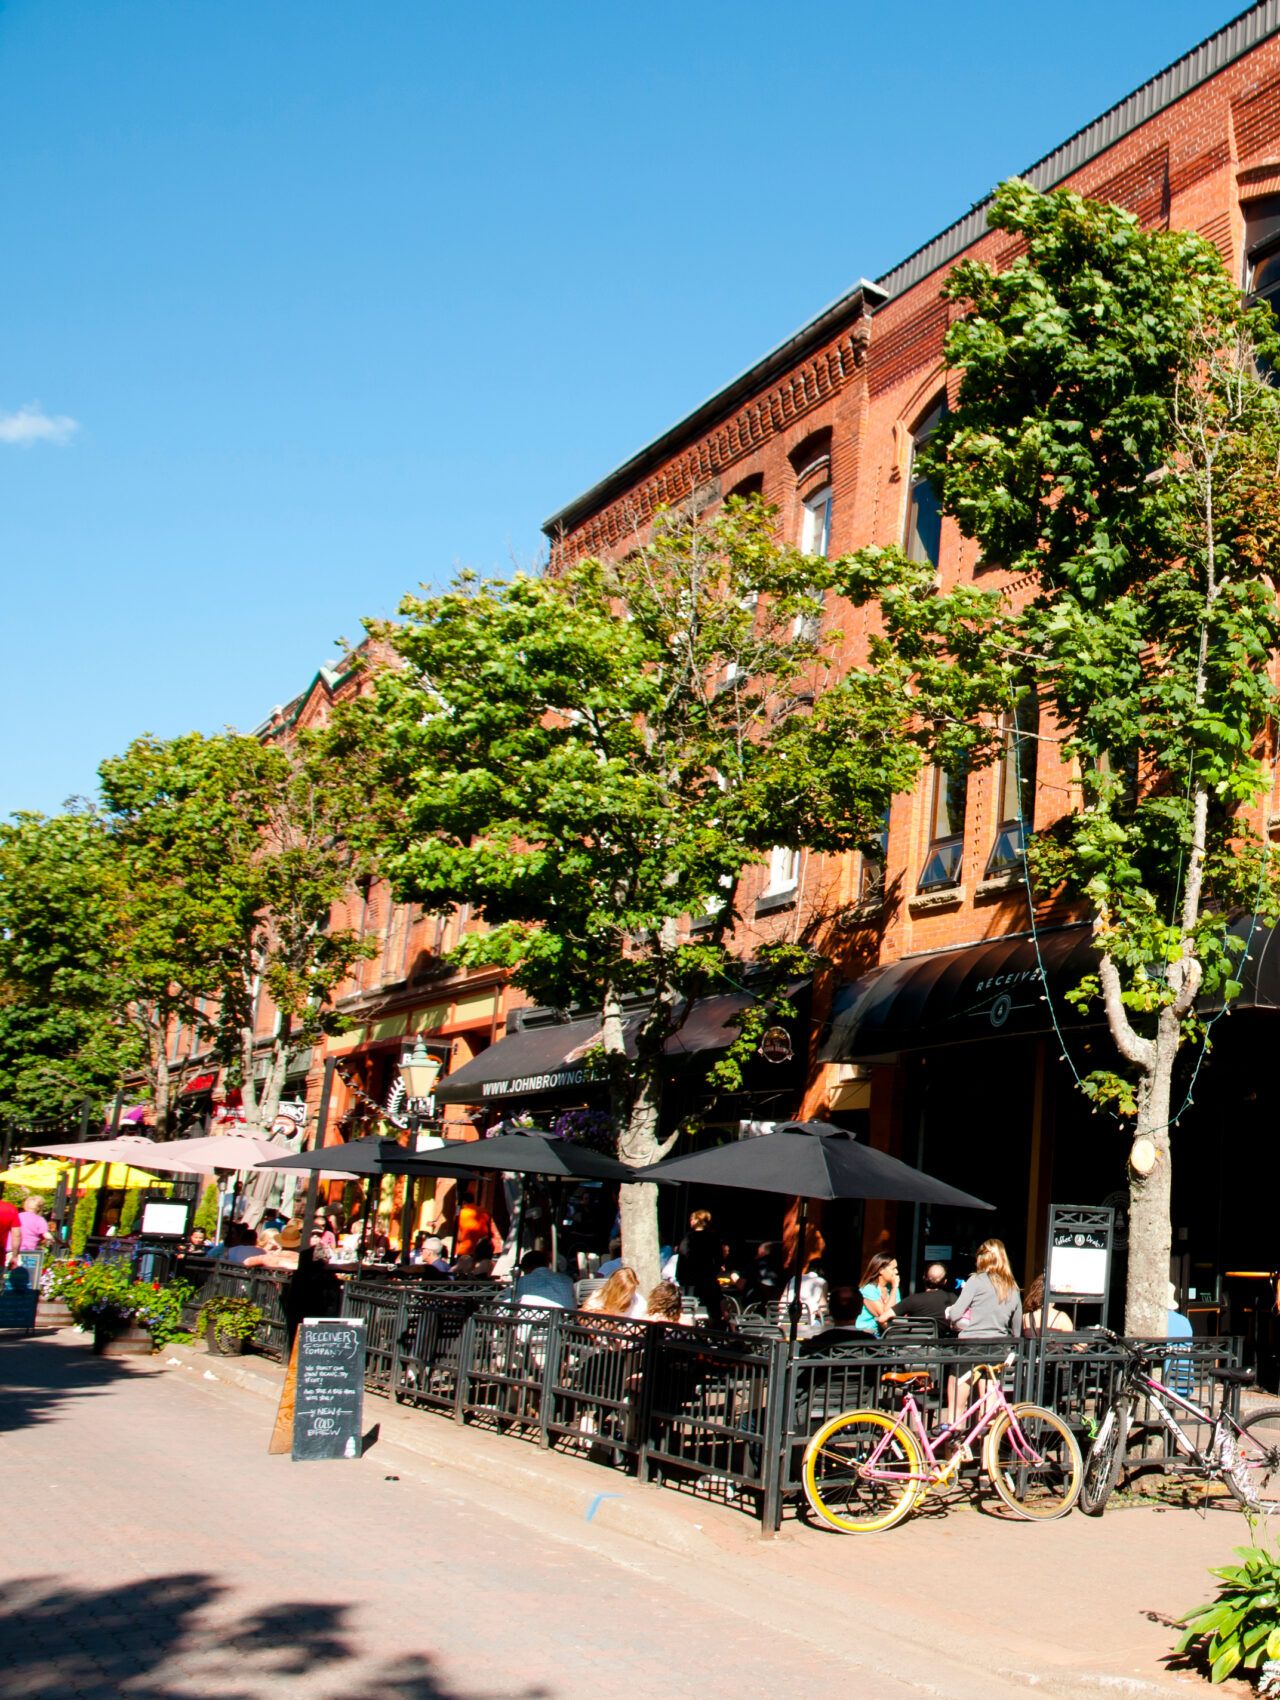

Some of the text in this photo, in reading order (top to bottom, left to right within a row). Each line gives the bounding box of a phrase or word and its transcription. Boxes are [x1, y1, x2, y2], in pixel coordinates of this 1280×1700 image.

[976, 970, 1048, 992] RECEIVER
[305, 1330, 351, 1343] RECEIVER
[304, 1348, 344, 1356] COMPANY
[317, 1407, 336, 1415] NEW
[314, 1417, 335, 1429] COLD
[307, 1426, 341, 1436] BREW
